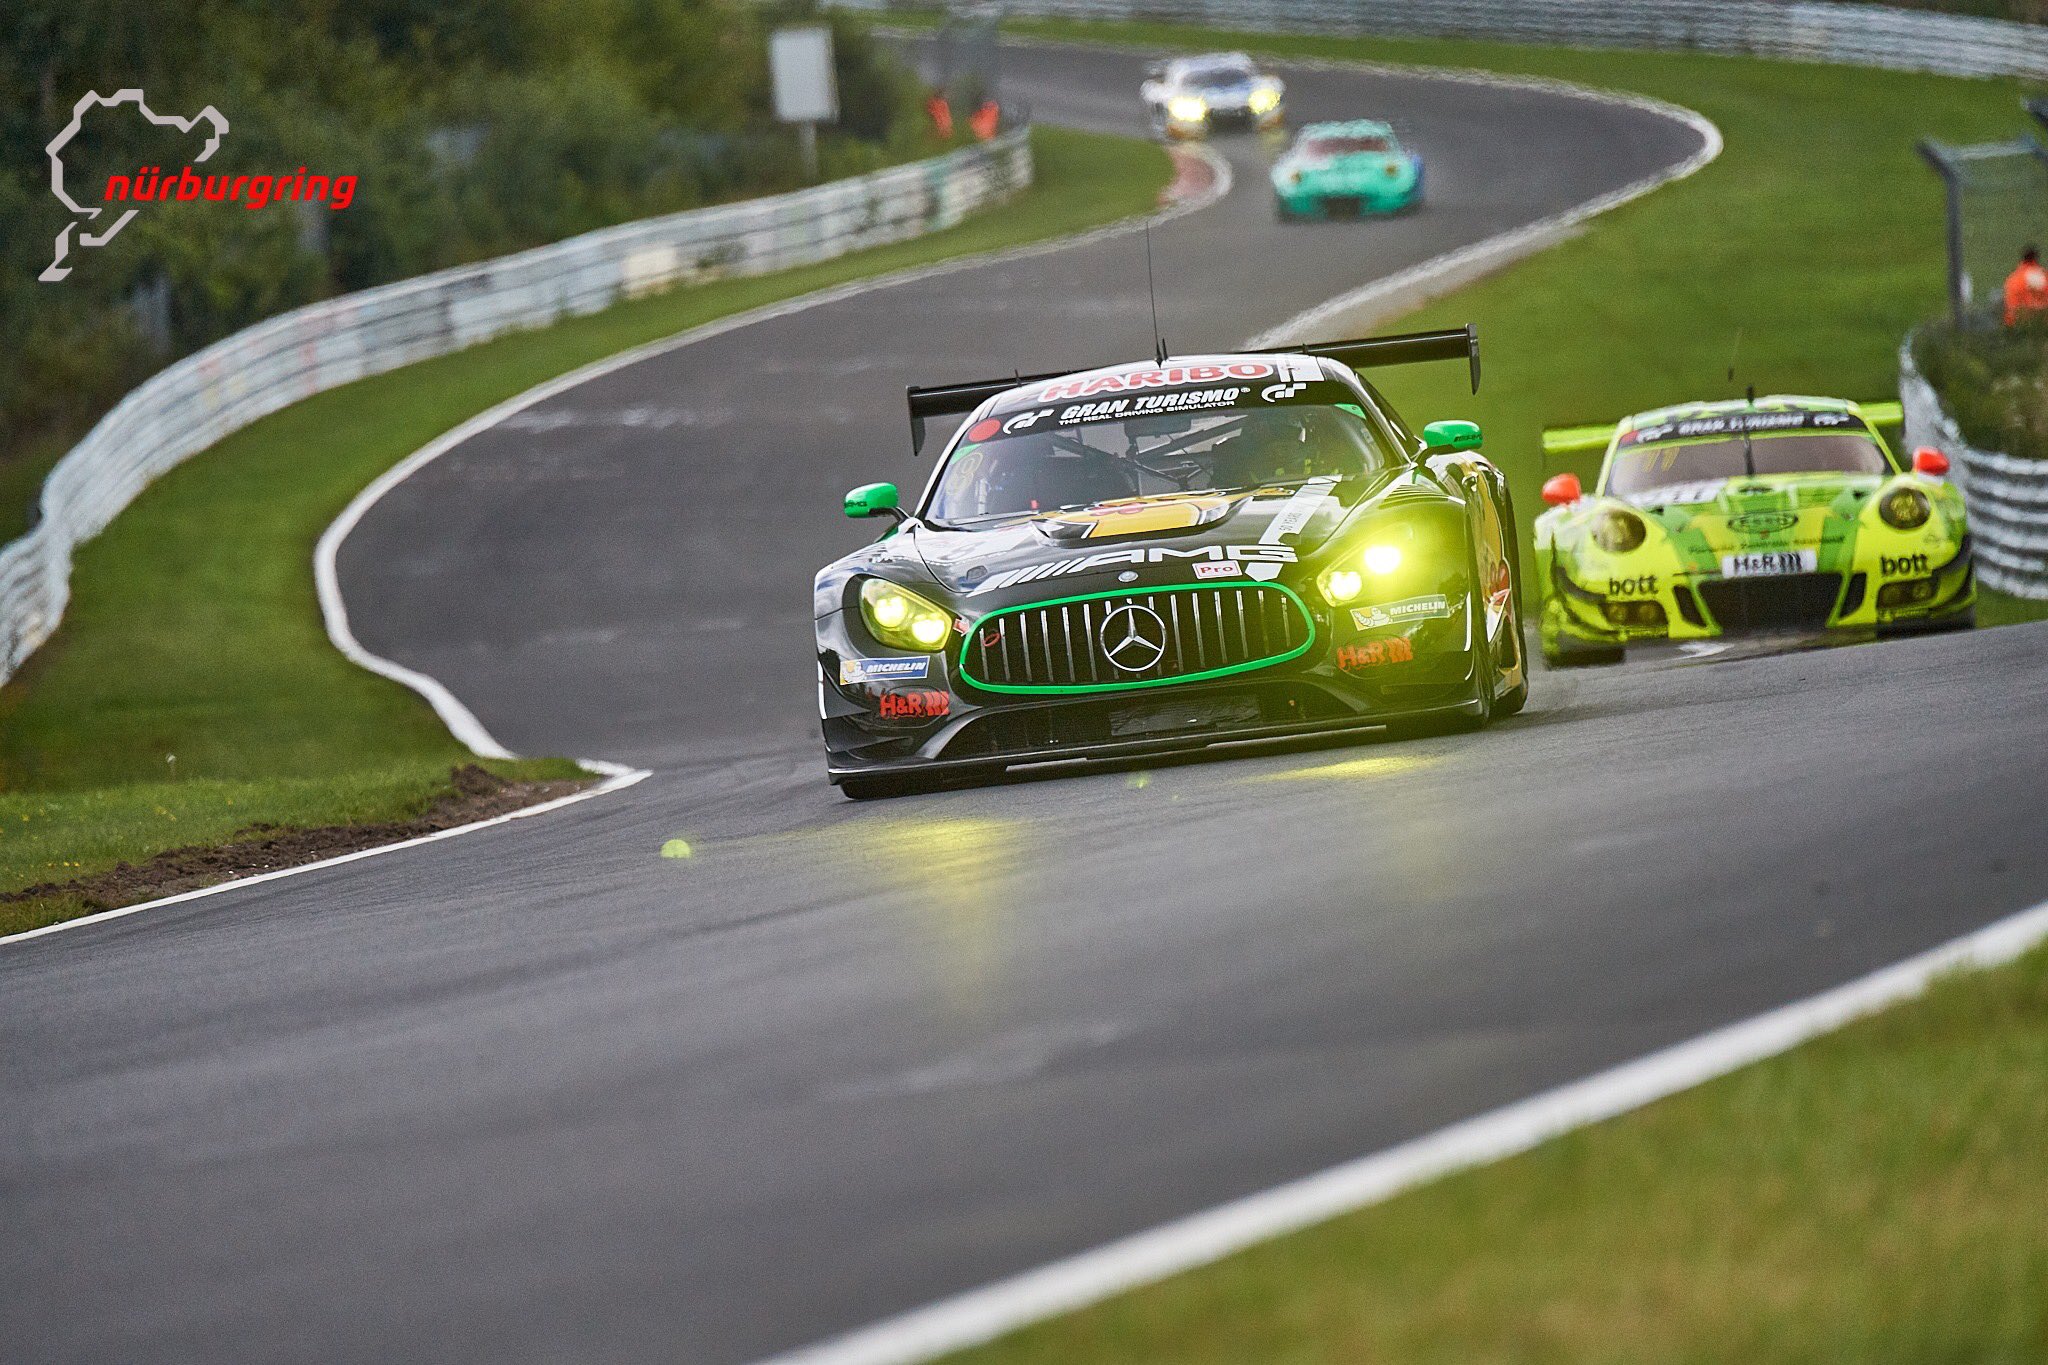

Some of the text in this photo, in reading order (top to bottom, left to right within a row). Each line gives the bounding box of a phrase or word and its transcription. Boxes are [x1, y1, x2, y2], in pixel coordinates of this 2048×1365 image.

[1042, 364, 1270, 401] HARIBO
[1059, 400, 1235, 426] THE REAL DRIVING SIMULATOR
[1060, 399, 1130, 420] GRAN
[1066, 545, 1298, 573] AMG
[1200, 565, 1234, 575] Pro
[1880, 553, 1928, 577] bott
[1609, 574, 1659, 596] bott
[1390, 601, 1446, 616] MICHELIN
[866, 661, 926, 673] MICHELIN
